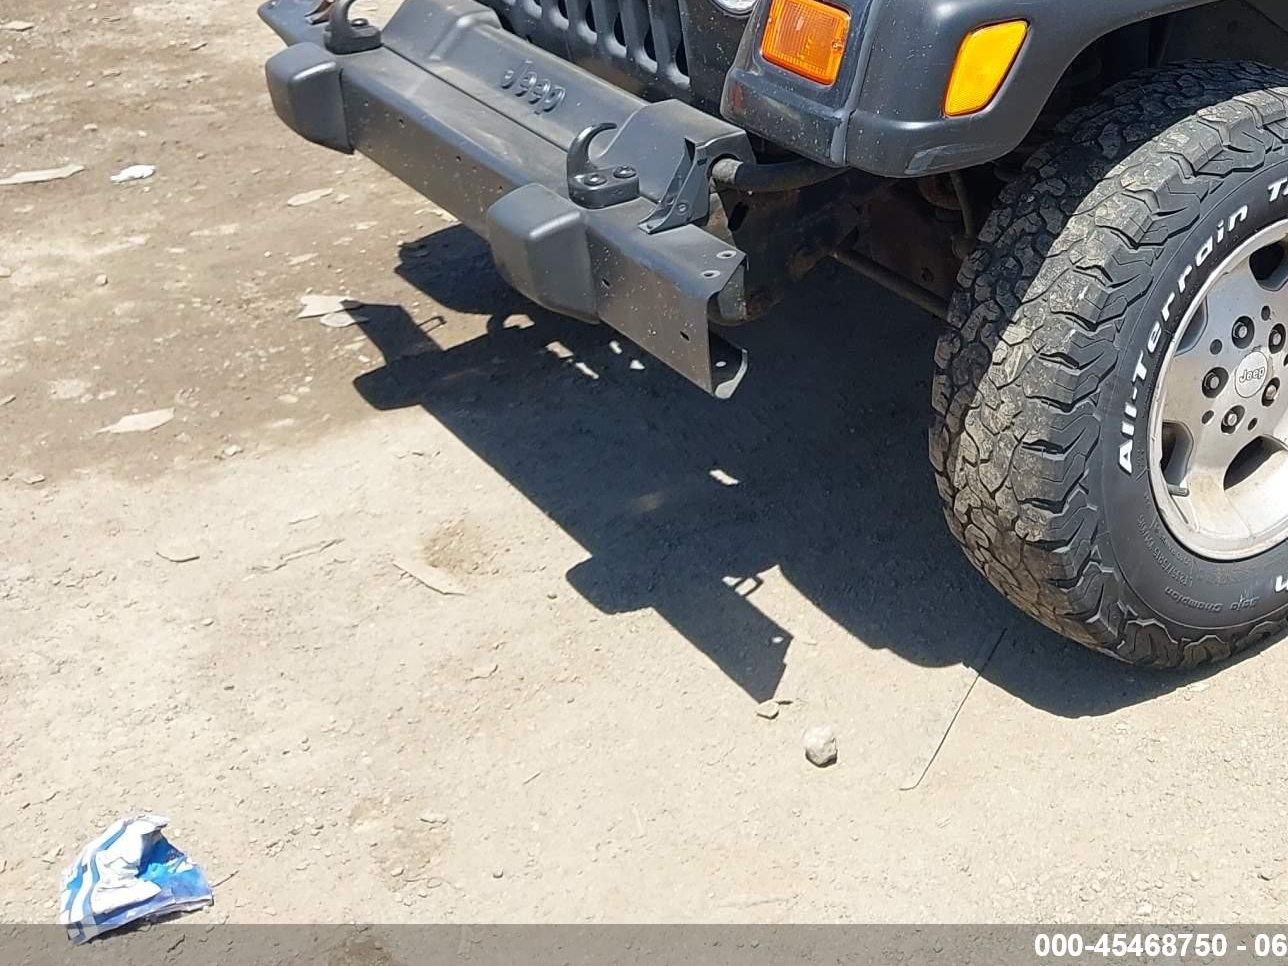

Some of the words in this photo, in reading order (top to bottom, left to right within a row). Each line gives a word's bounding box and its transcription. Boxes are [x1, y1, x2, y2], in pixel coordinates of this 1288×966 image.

[500, 58, 567, 116] Jeep
[1119, 204, 1249, 474] All-Terrain
[1238, 366, 1266, 383] Jeep
